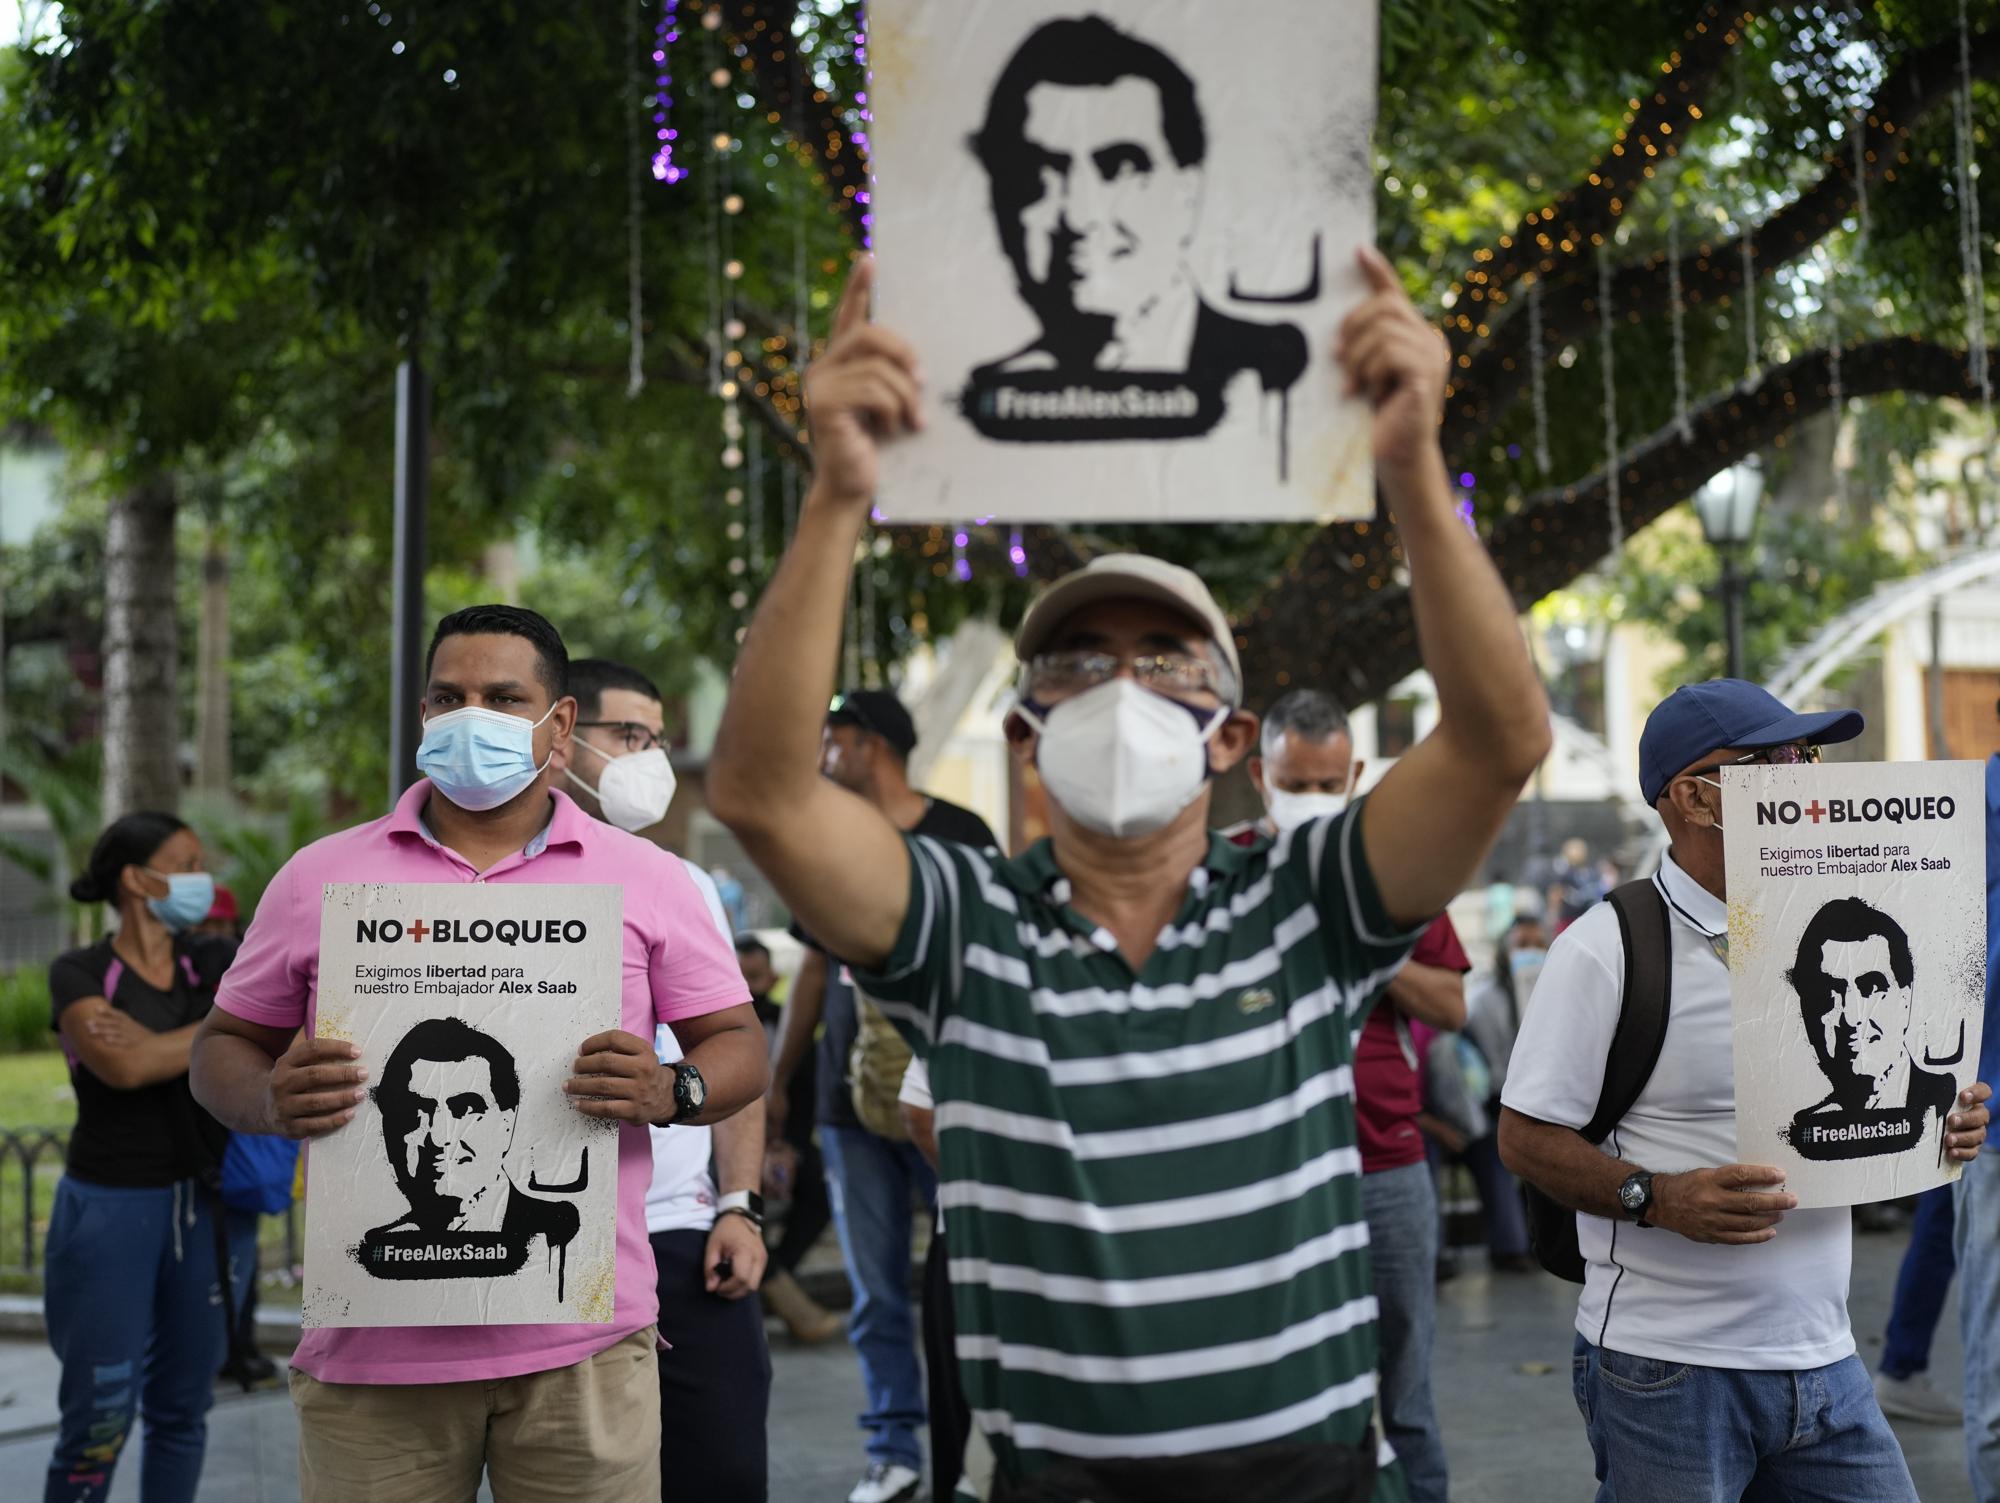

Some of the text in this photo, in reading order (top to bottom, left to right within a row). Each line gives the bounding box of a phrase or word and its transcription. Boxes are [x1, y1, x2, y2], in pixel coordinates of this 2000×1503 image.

[1760, 844, 1910, 863] Exigimos libertad para
[1761, 857, 1951, 877] nuestro Embajador Alex Saab
[355, 964, 524, 981] Exigimos libertad para
[354, 981, 577, 997] nuestro Embajador Alex Saab
[1802, 1119, 1911, 1143] #FreeAlexSaab
[372, 1243, 508, 1262] #FreeAlexSaab
